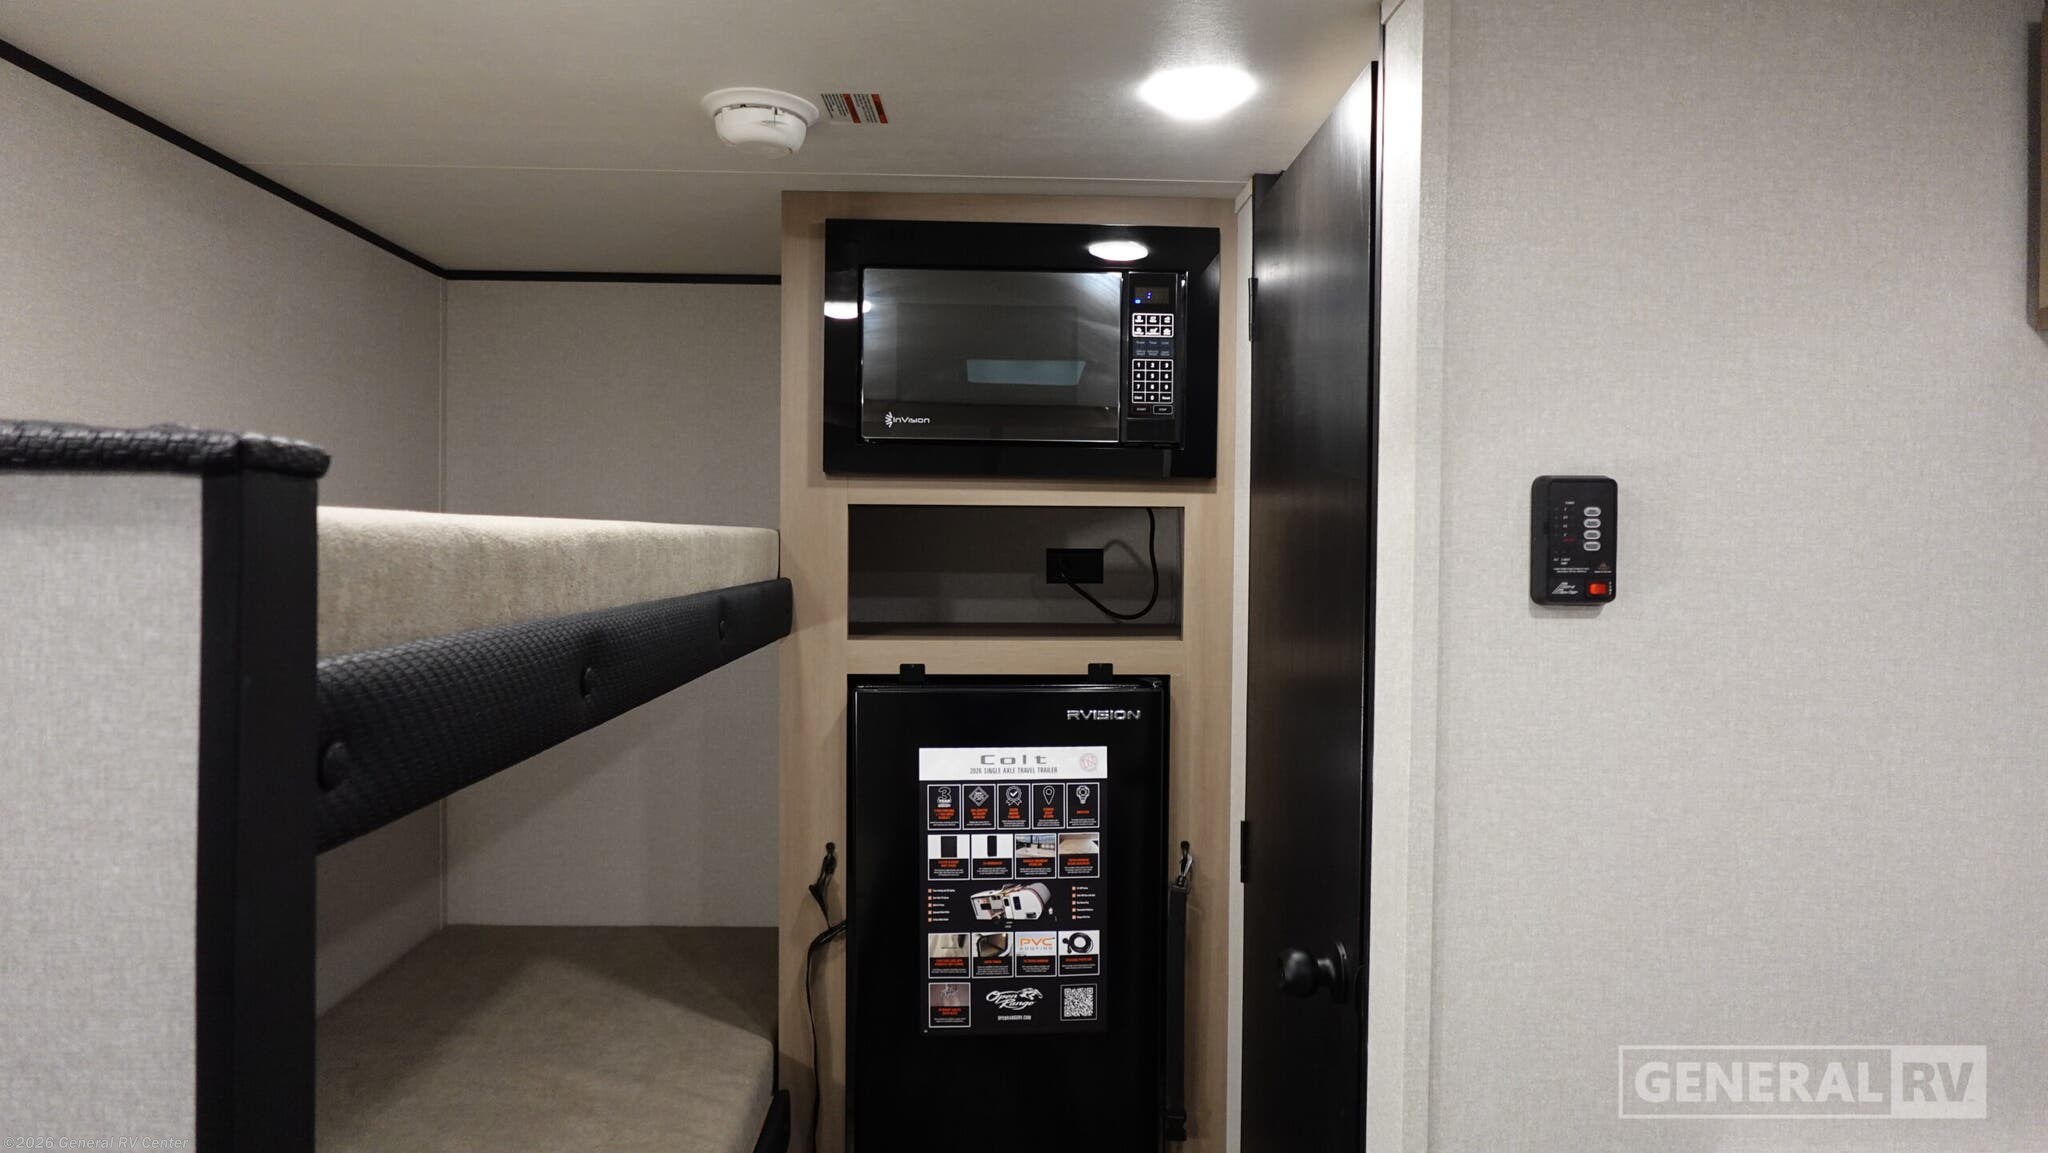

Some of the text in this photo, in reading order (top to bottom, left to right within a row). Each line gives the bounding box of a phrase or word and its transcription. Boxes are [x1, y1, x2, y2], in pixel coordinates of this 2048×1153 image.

[1066, 709, 1141, 720] RVISION
[980, 754, 1048, 765] Colt
[938, 786, 952, 801] 3
[1020, 936, 1053, 946] PVC
[986, 990, 1018, 1004] Open
[999, 998, 1035, 1010] Range
